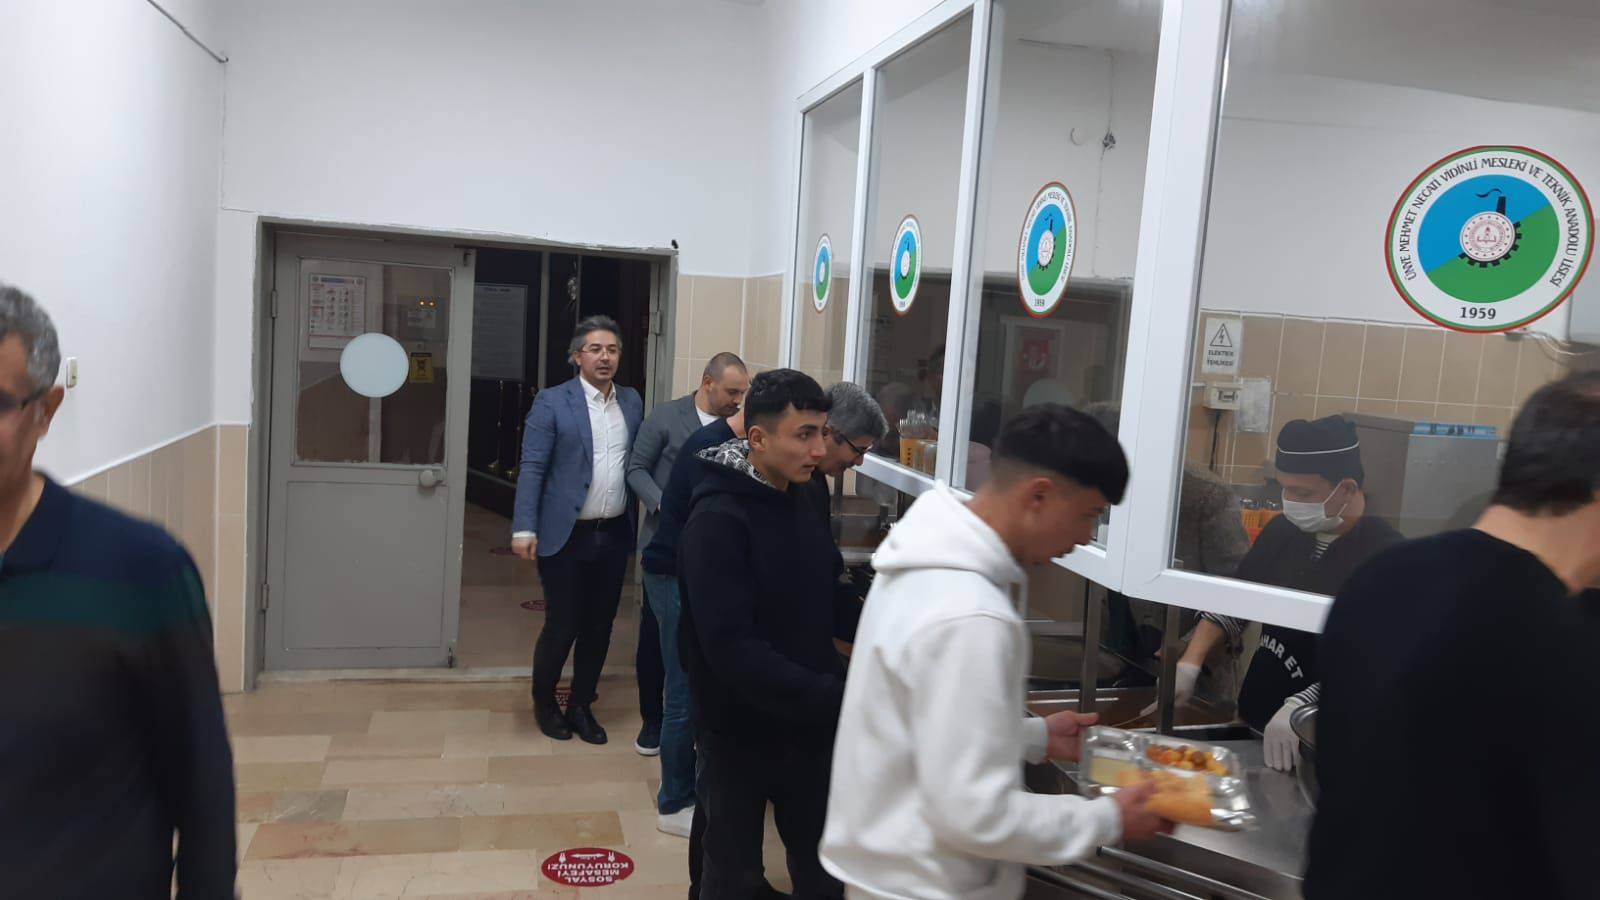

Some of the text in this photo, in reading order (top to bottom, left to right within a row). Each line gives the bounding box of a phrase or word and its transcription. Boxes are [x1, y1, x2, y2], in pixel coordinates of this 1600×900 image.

[1481, 158, 1528, 171] MESLEKİ
[1528, 164, 1544, 179] VE
[1541, 172, 1573, 207] TEKNİK
[1400, 209, 1417, 252] MEHMET
[1564, 207, 1579, 256] ANADOLU
[1400, 255, 1417, 281] ÜNYE
[1459, 306, 1497, 320] 1959
[1284, 656, 1303, 678] ET
